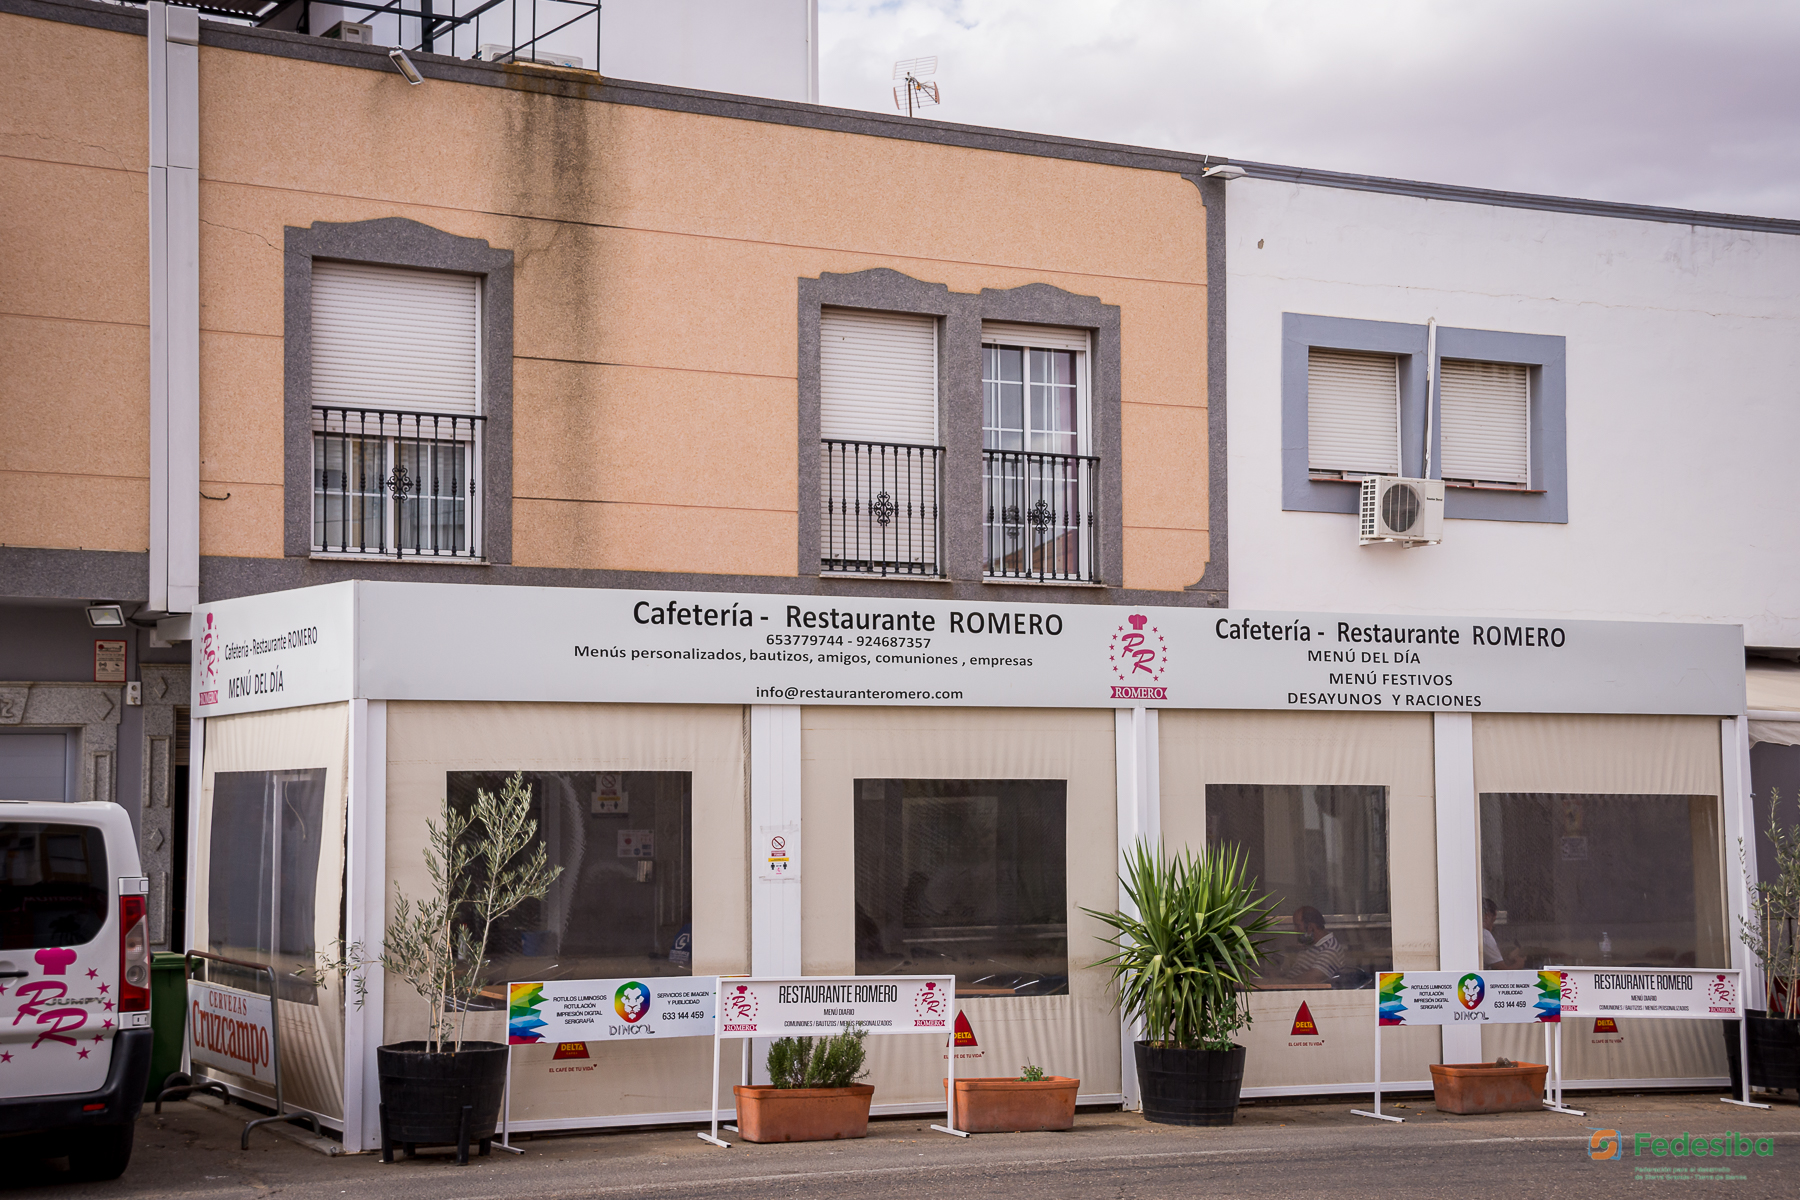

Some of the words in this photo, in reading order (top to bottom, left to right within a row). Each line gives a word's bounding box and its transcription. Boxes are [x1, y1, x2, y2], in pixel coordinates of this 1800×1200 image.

[633, 600, 753, 627] Cafetería
[786, 605, 936, 632] Restaurante
[950, 611, 1063, 636] ROMERO
[766, 634, 844, 646] 653779744
[856, 636, 931, 648] 924687357
[1215, 618, 1311, 642] Cafetería
[1337, 622, 1460, 645] Restaurante
[1472, 625, 1566, 648] ROMERO
[224, 640, 249, 660] Cafetería
[252, 634, 286, 656] Restaurante
[288, 626, 318, 649] ROMERO
[574, 645, 626, 658] Menús
[631, 648, 747, 663] personalizados,
[750, 649, 813, 664] bautizos,
[818, 652, 871, 666] amigos,
[875, 653, 958, 665] comuniones
[969, 656, 1033, 668] empresas
[1308, 648, 1356, 663] MENÚ
[1361, 652, 1389, 664] DEL
[1394, 650, 1421, 664] DÍA
[228, 669, 252, 699] MENÚ
[254, 672, 268, 694] DEL
[270, 665, 284, 692] DÍA
[1329, 670, 1377, 685] MENÚ
[1382, 674, 1453, 686] FESTIVOS
[756, 687, 963, 700] info@restauranteromero.com
[1114, 686, 1164, 699] ROMERO
[1288, 692, 1382, 705] DESAYUNOS
[1392, 694, 1400, 705] Y
[1405, 694, 1482, 707] RACIONES
[1594, 974, 1655, 990] RESTAURANTE
[1657, 975, 1693, 990] ROMERO
[778, 985, 852, 1004] RESTAURANTE
[855, 985, 898, 1003] ROMERO
[209, 990, 247, 1016] CERVEZAS
[662, 1012, 676, 1020] 633
[677, 1011, 689, 1020] 144
[691, 1010, 704, 1019] 459
[192, 1000, 269, 1076] Cruzcampo
[561, 1043, 584, 1051] DELTA
